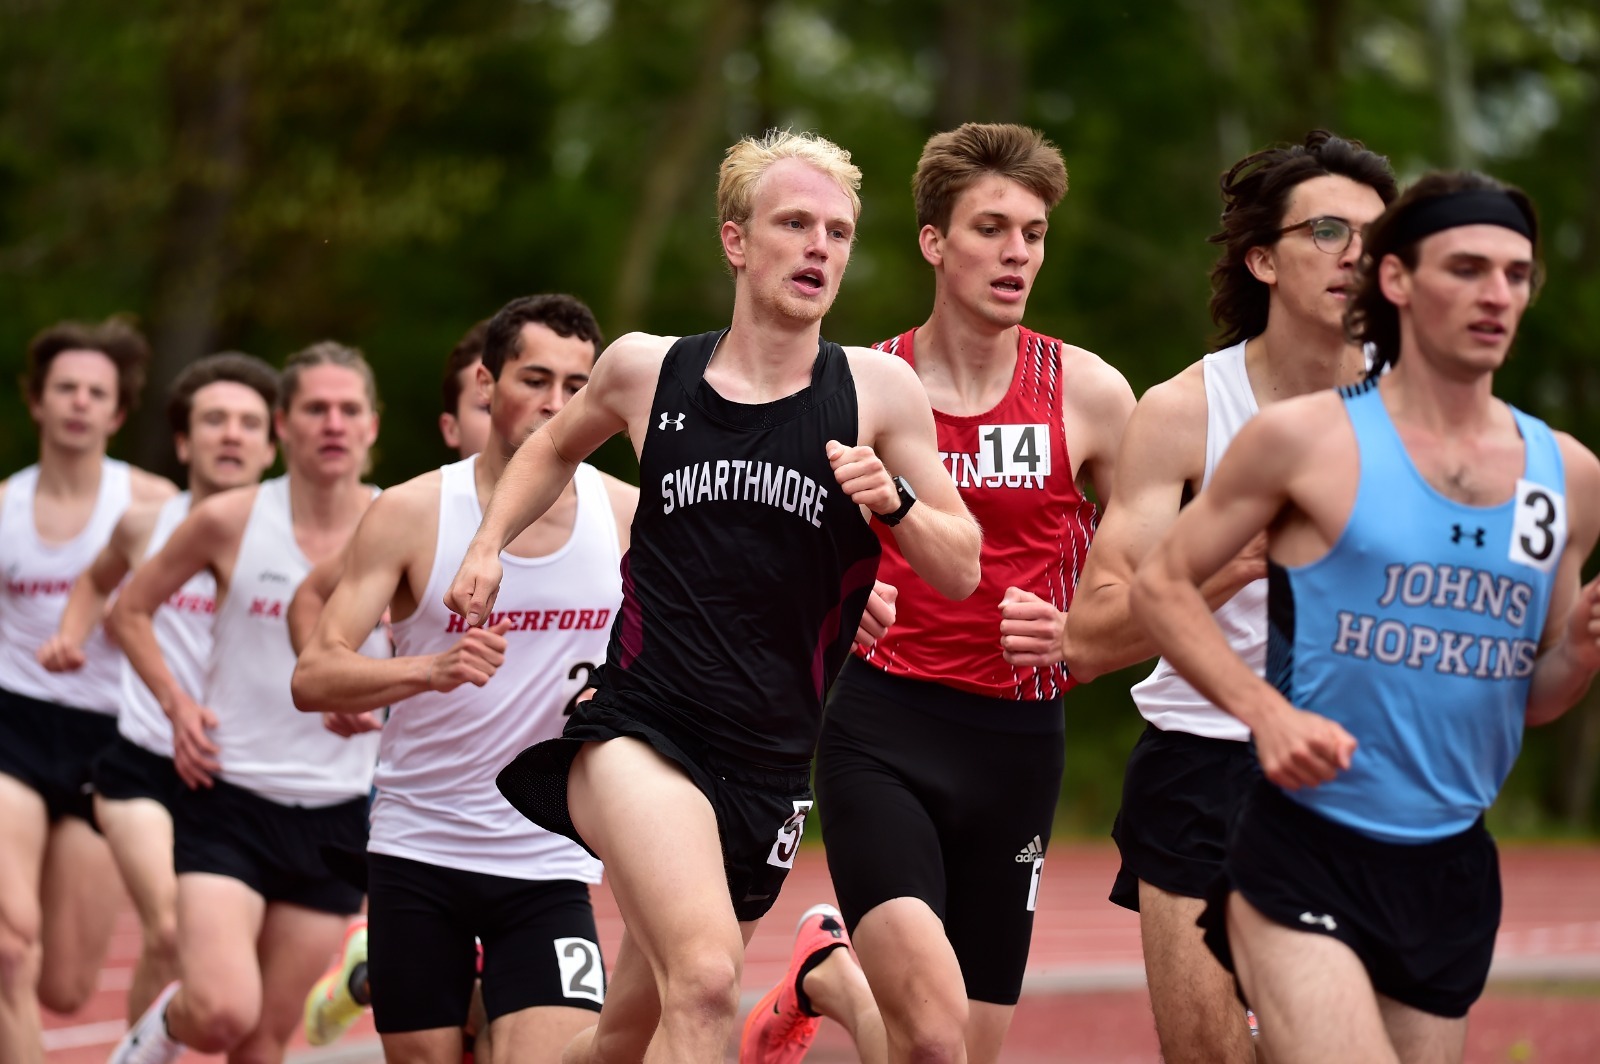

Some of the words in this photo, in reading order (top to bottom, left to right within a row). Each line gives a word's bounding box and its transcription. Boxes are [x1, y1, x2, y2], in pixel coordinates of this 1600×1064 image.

[984, 426, 1041, 473] 14
[661, 459, 828, 528] SWARTHMORE
[1520, 490, 1556, 562] 3
[446, 609, 611, 633] HVERFORD
[1378, 562, 1533, 628] JOHNS
[1332, 611, 1538, 679] HOPKINS
[563, 661, 596, 716] 2
[564, 942, 598, 995] 2
